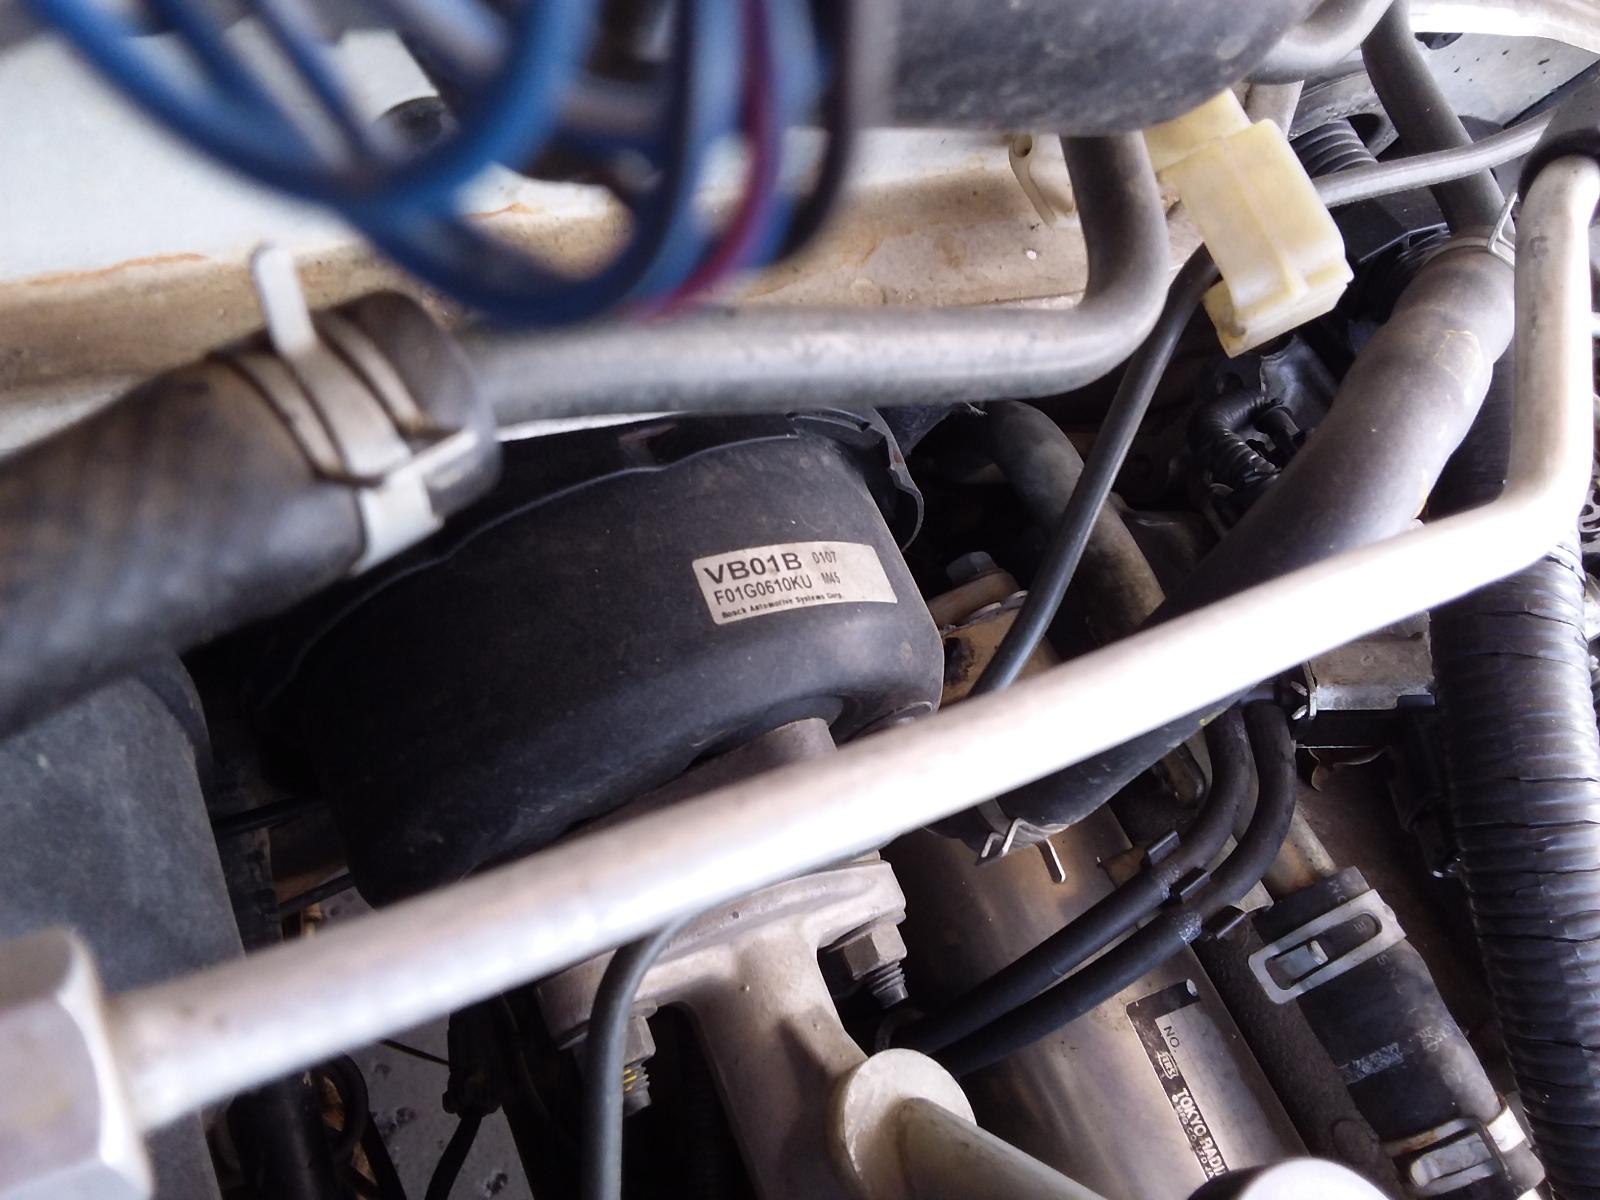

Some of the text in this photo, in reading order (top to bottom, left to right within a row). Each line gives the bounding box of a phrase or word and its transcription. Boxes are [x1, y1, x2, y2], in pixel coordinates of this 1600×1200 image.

[703, 552, 803, 585] VB01B
[812, 551, 837, 564] 0107
[713, 575, 813, 606] F01G0610KU
[1163, 1025, 1181, 1053] NO.
[1177, 1087, 1207, 1137] TOKYO
